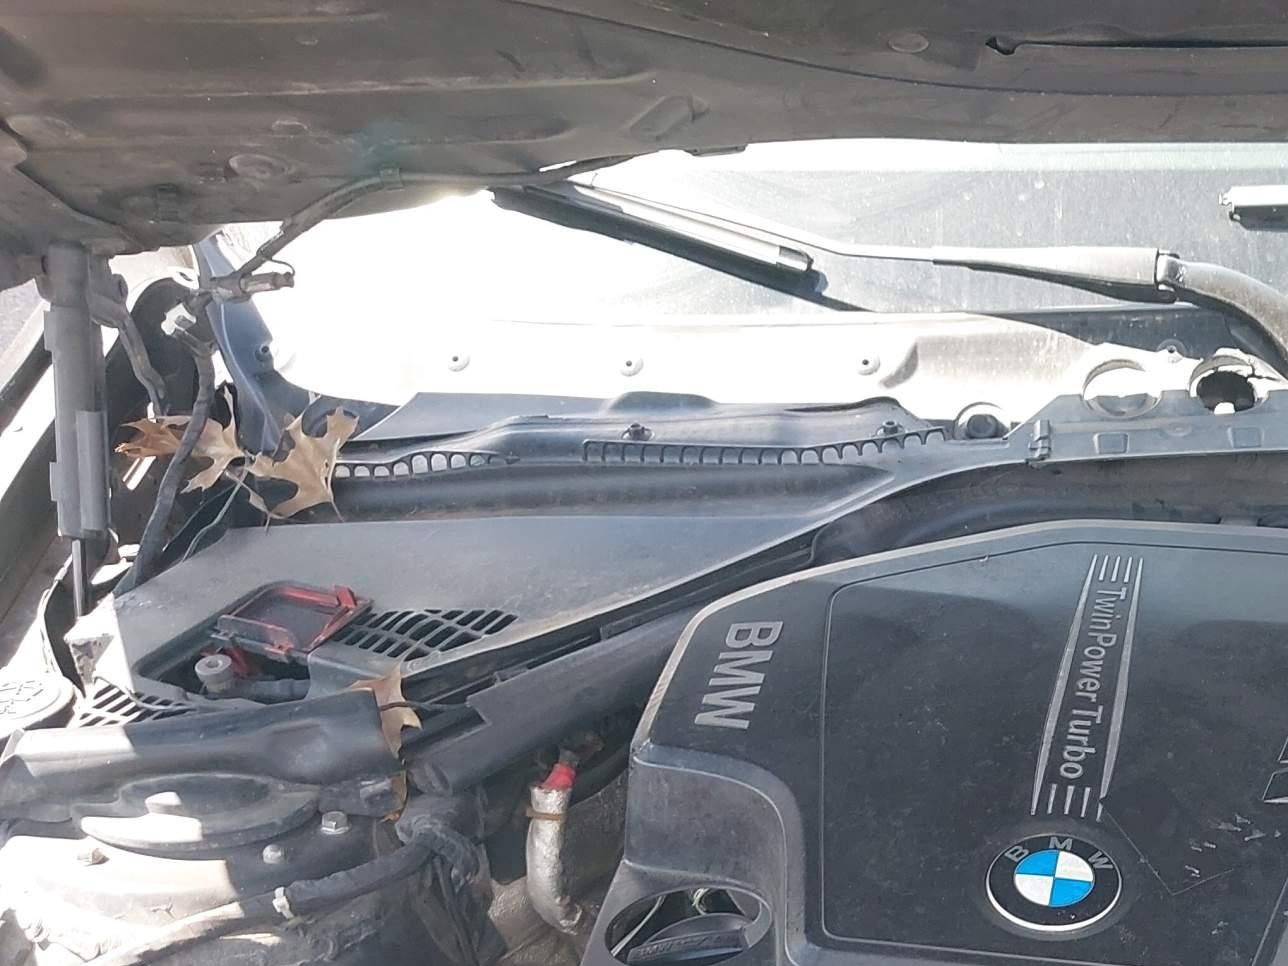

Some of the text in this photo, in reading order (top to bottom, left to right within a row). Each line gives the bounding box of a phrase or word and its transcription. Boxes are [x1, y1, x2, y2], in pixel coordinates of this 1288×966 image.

[694, 620, 784, 730] BMW
[1058, 586, 1128, 780] TwinPower Turbo
[1004, 836, 1114, 870] BMW
